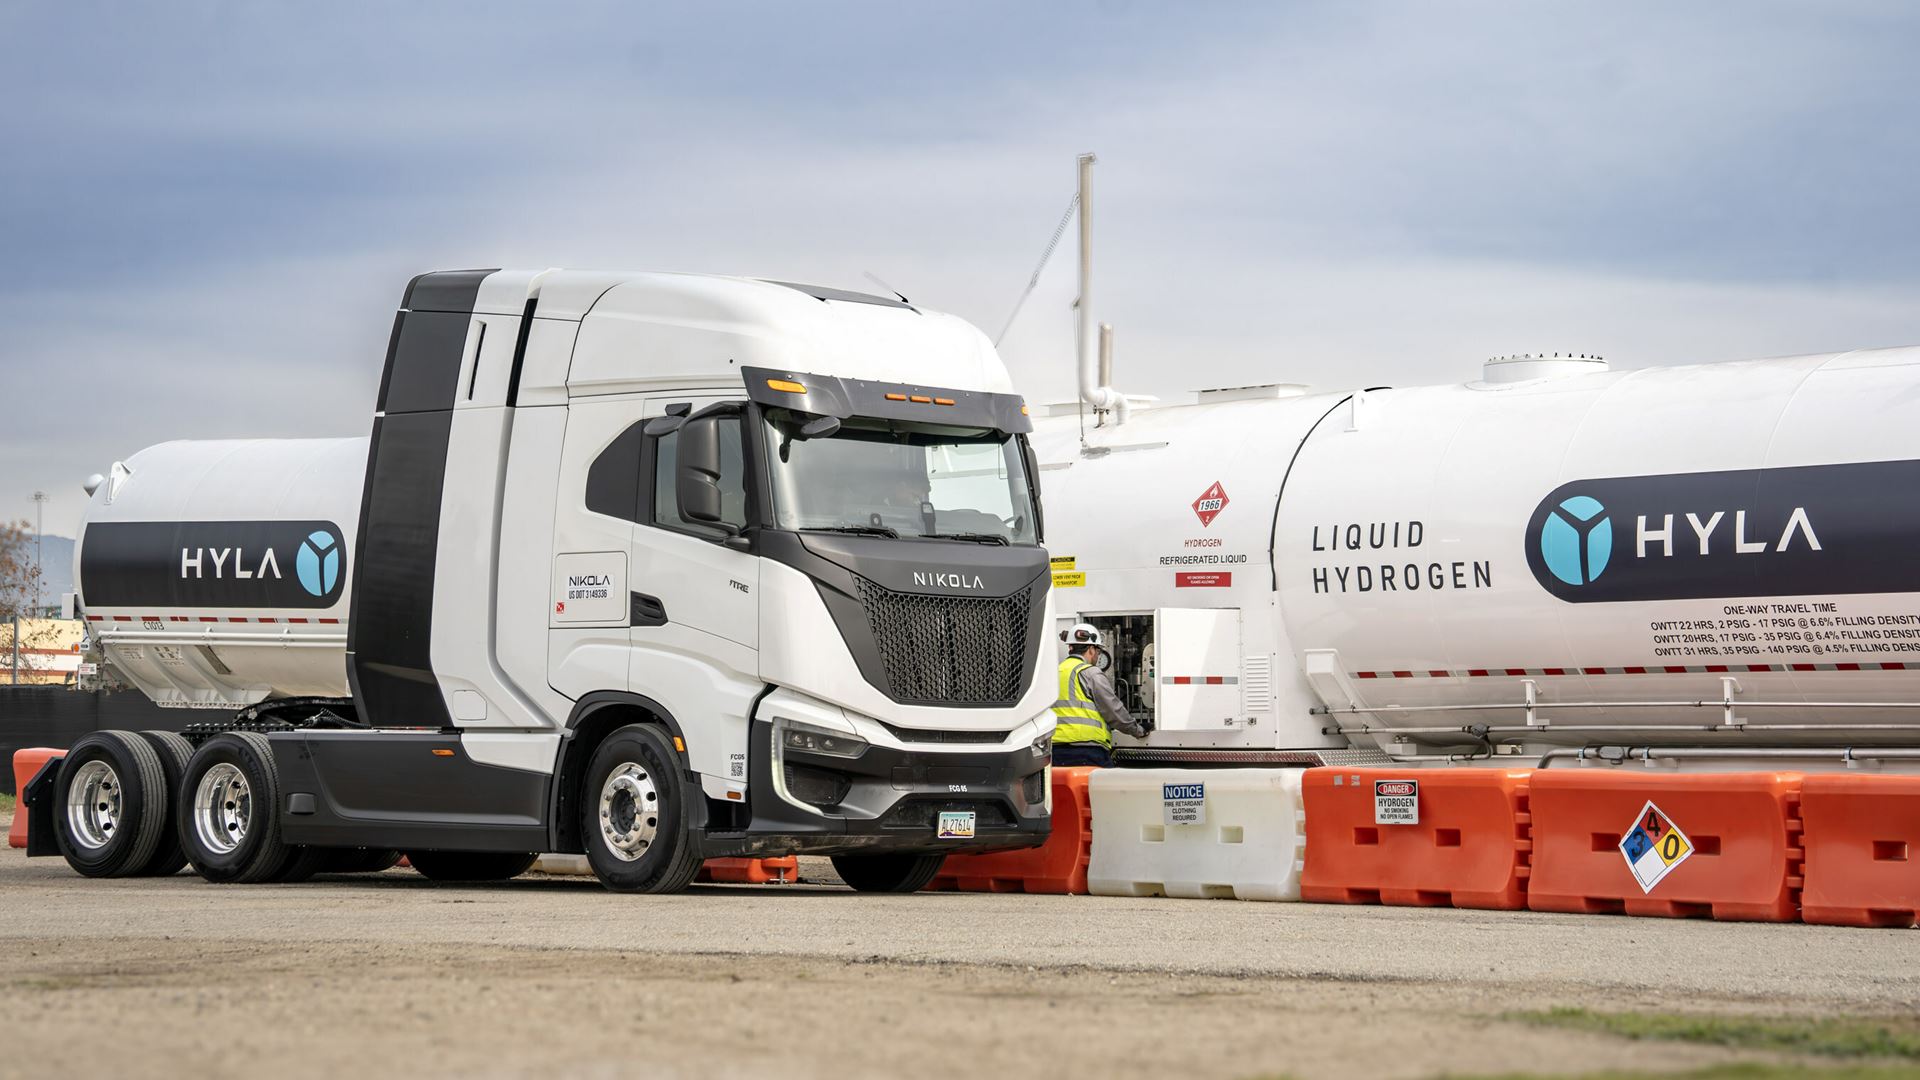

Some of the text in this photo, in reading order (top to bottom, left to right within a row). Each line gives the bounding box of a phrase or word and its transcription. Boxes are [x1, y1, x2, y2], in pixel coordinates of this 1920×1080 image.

[1200, 500, 1220, 510] 1966
[1312, 521, 1423, 551] LIQUID
[1636, 507, 1822, 557] HYLA
[1184, 539, 1222, 547] HYDROGEN
[181, 548, 281, 578] HYLA
[1160, 554, 1247, 565] REFRIGERATED LIQUID
[569, 575, 610, 586] NIKOLA
[913, 572, 984, 589] NIKOLA
[1312, 561, 1491, 593] HYDROGEN
[569, 589, 607, 599] US DOT 3149336
[1724, 603, 1837, 615] ONE-WAY TRAVEL TIME
[143, 622, 164, 630] C1013
[1651, 622, 1679, 630] OWTT
[1679, 621, 1692, 630] 22
[1694, 620, 1718, 630] HRS,
[1719, 620, 1725, 628] 2
[1728, 619, 1750, 628] PSIG
[1773, 618, 1796, 627] PSIG
[1798, 618, 1809, 629] @
[1810, 617, 1834, 627] 6.6%
[1836, 616, 1876, 626] FILLING
[1654, 635, 1680, 643] OWTT
[1733, 633, 1756, 641] PSIG
[1778, 632, 1801, 641] PSIG
[1803, 632, 1815, 642] @
[1816, 631, 1840, 640] 6.4%
[1841, 630, 1881, 639] FILLING
[1655, 648, 1682, 656] OWTT
[1684, 647, 1696, 655] 31
[1697, 646, 1722, 656] HRS,
[1723, 646, 1735, 654] 35
[1736, 645, 1760, 655] PSIG
[1768, 645, 1784, 654] 140
[1786, 645, 1811, 654] PSIG
[1812, 645, 1824, 655] @
[1825, 644, 1849, 653] 4.5%
[1850, 643, 1890, 652] FILLING
[1165, 786, 1202, 798] NOTICE
[1383, 785, 1409, 793] DANGER
[1379, 798, 1414, 807] HYDROGEN
[1647, 812, 1660, 837] 4
[1631, 832, 1645, 857] 3
[1663, 834, 1680, 860] 0
